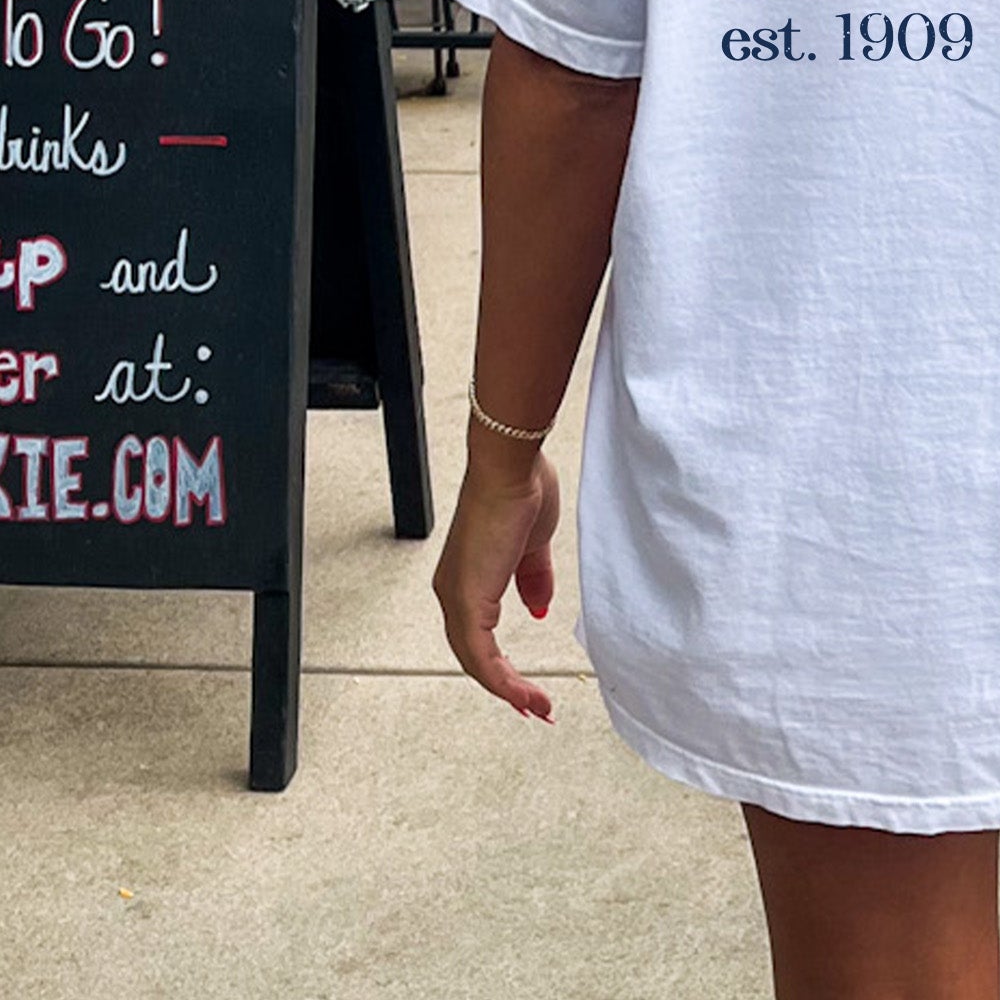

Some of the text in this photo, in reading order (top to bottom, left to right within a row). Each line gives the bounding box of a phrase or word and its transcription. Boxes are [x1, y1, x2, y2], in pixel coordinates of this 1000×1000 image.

[722, 12, 973, 62] est. 1909
[100, 228, 217, 293] and
[95, 334, 211, 403] at:
